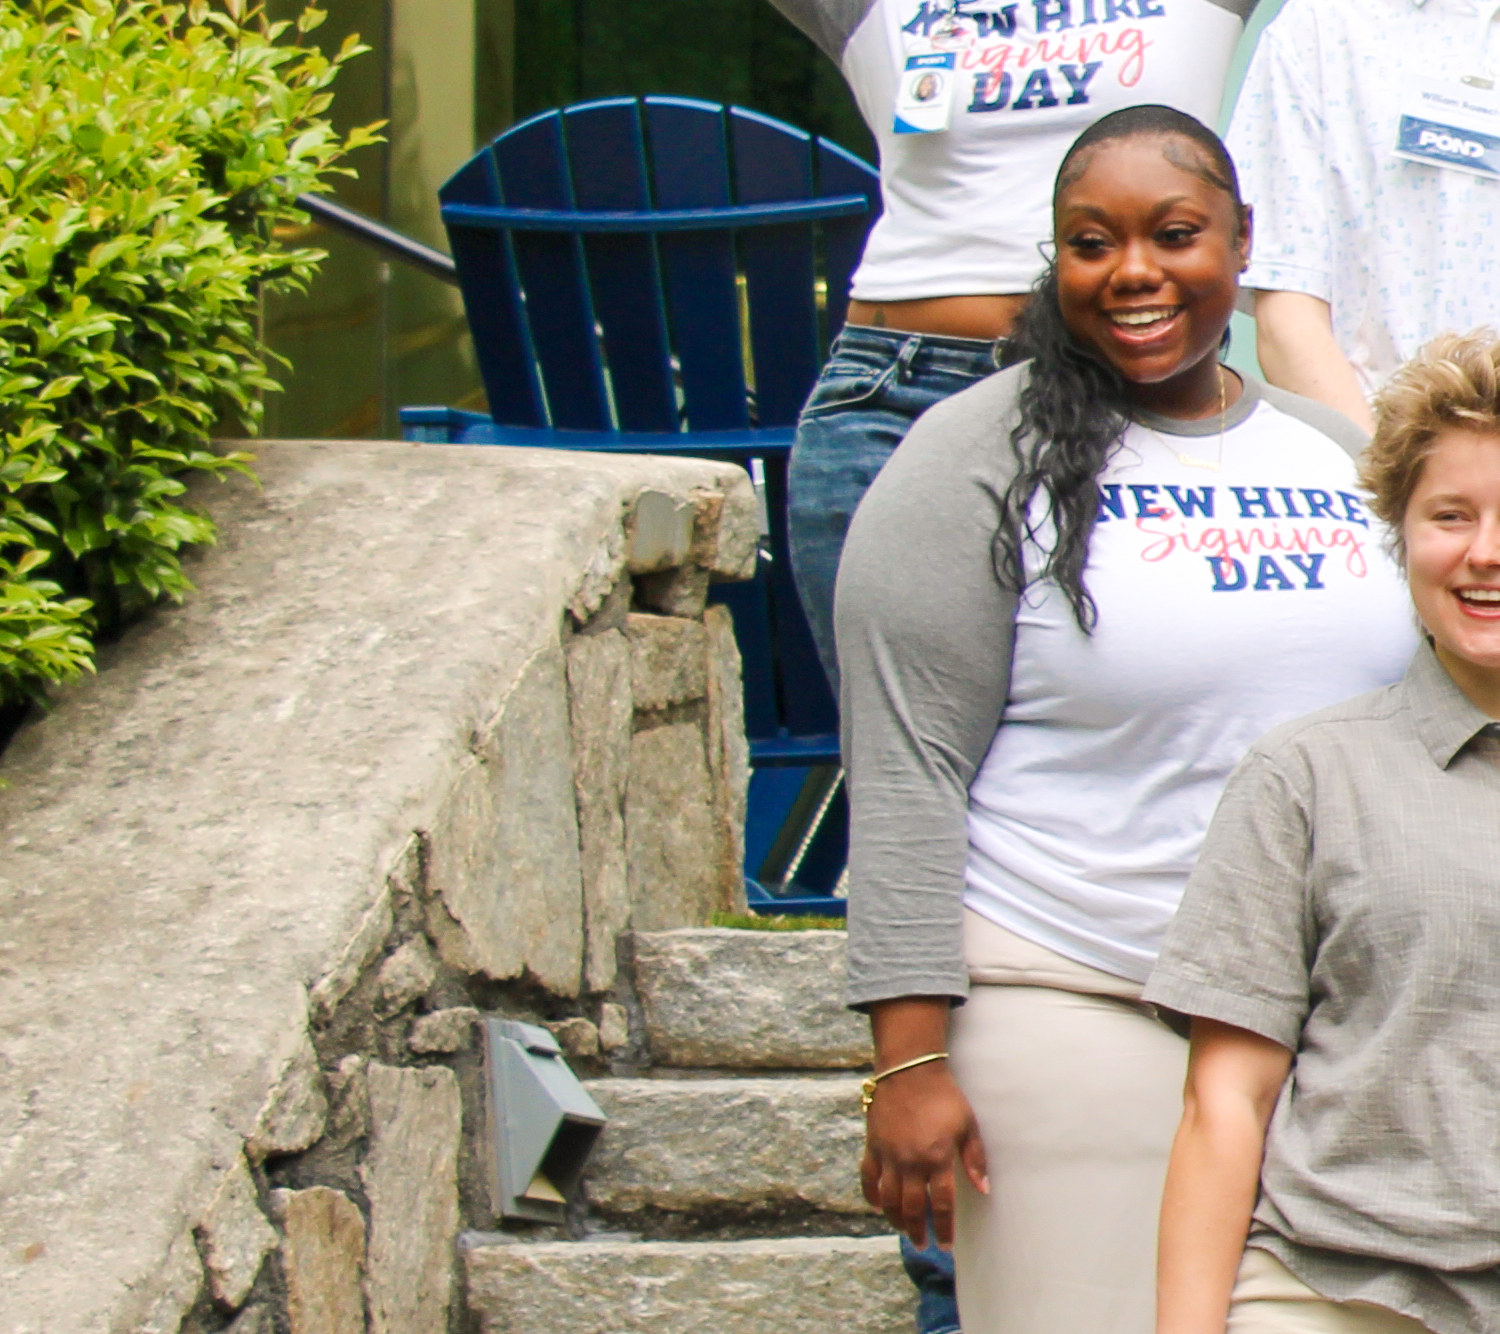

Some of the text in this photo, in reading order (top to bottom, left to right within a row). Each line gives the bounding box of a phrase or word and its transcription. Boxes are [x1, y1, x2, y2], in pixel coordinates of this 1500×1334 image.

[967, 61, 1102, 113] DAY
[1418, 130, 1486, 158] POND
[1096, 483, 1369, 530] NEW HIRE
[1135, 506, 1368, 579] Signing
[1204, 553, 1326, 592] DAY
